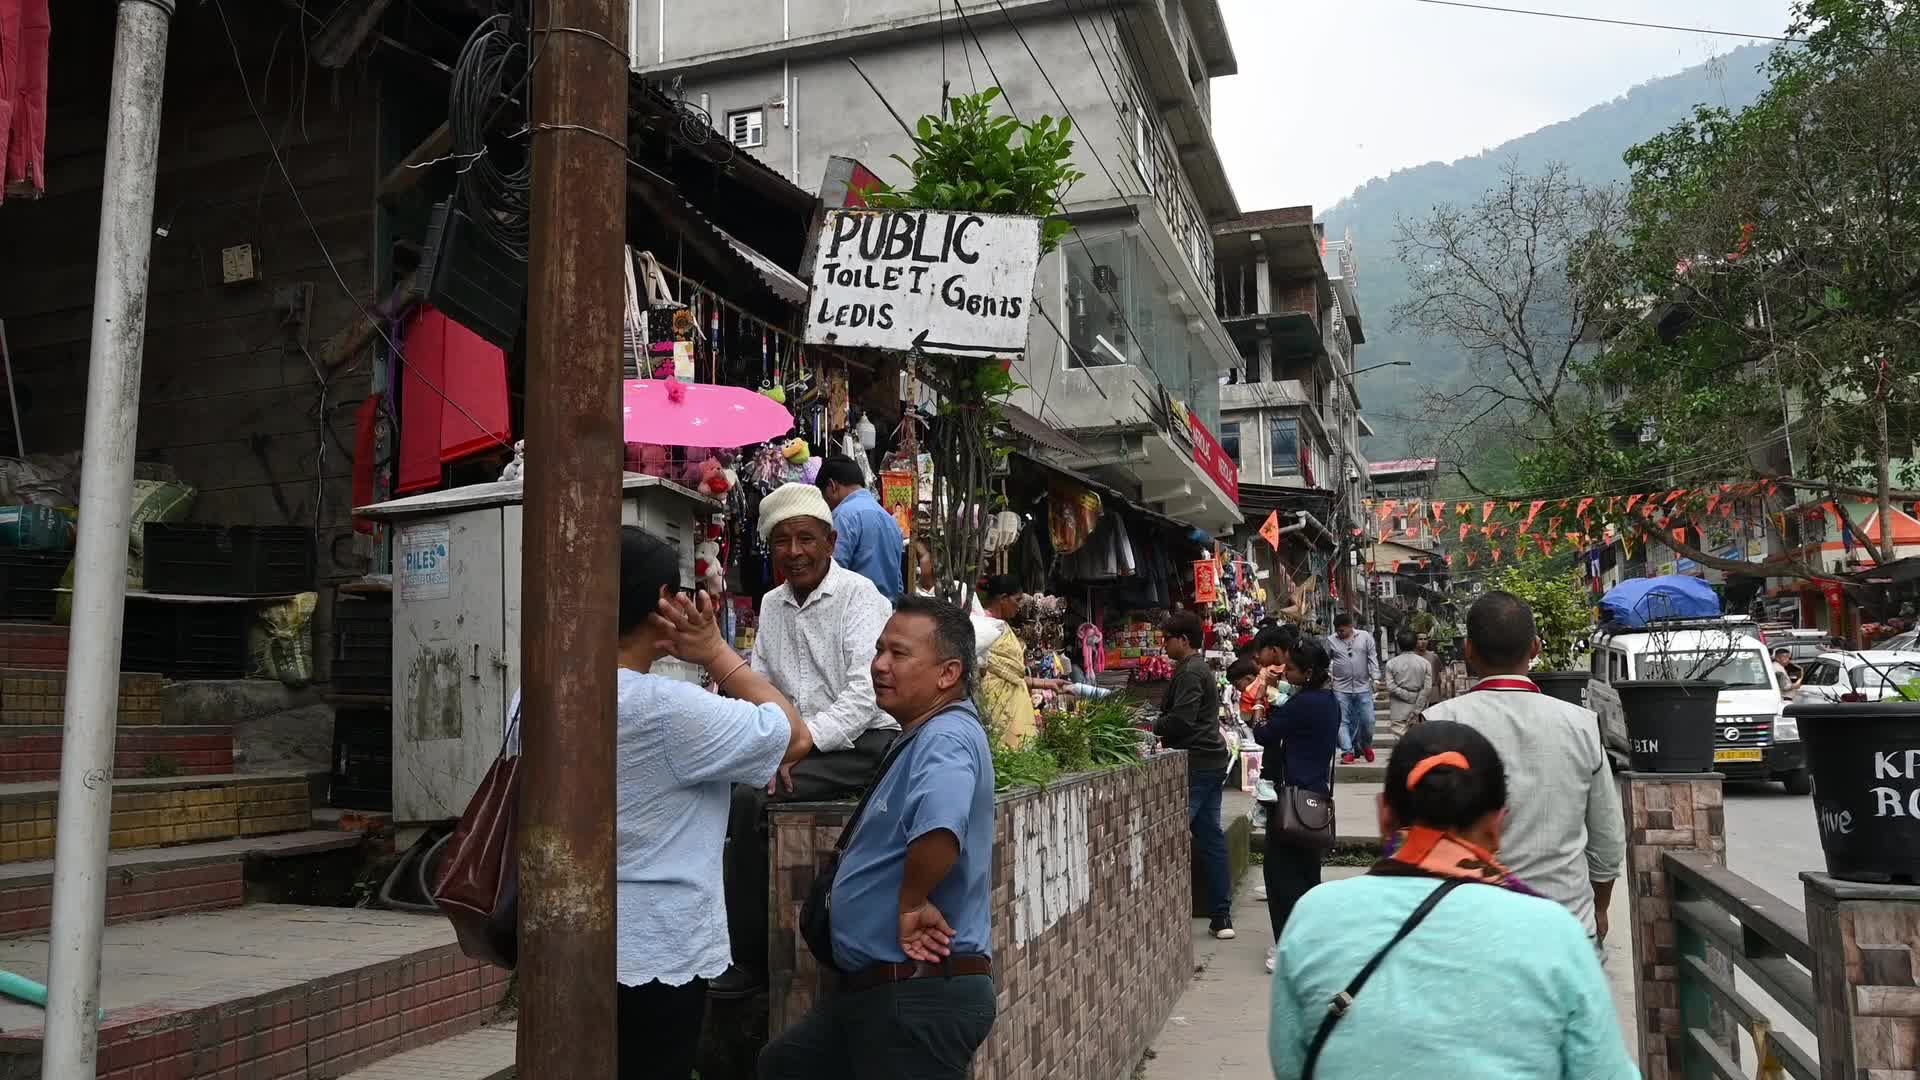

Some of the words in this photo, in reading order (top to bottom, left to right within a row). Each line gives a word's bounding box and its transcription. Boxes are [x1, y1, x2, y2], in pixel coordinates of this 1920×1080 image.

[826, 213, 984, 264] PUBLIC
[817, 298, 894, 329] LEDIS
[406, 550, 436, 570] PILES
